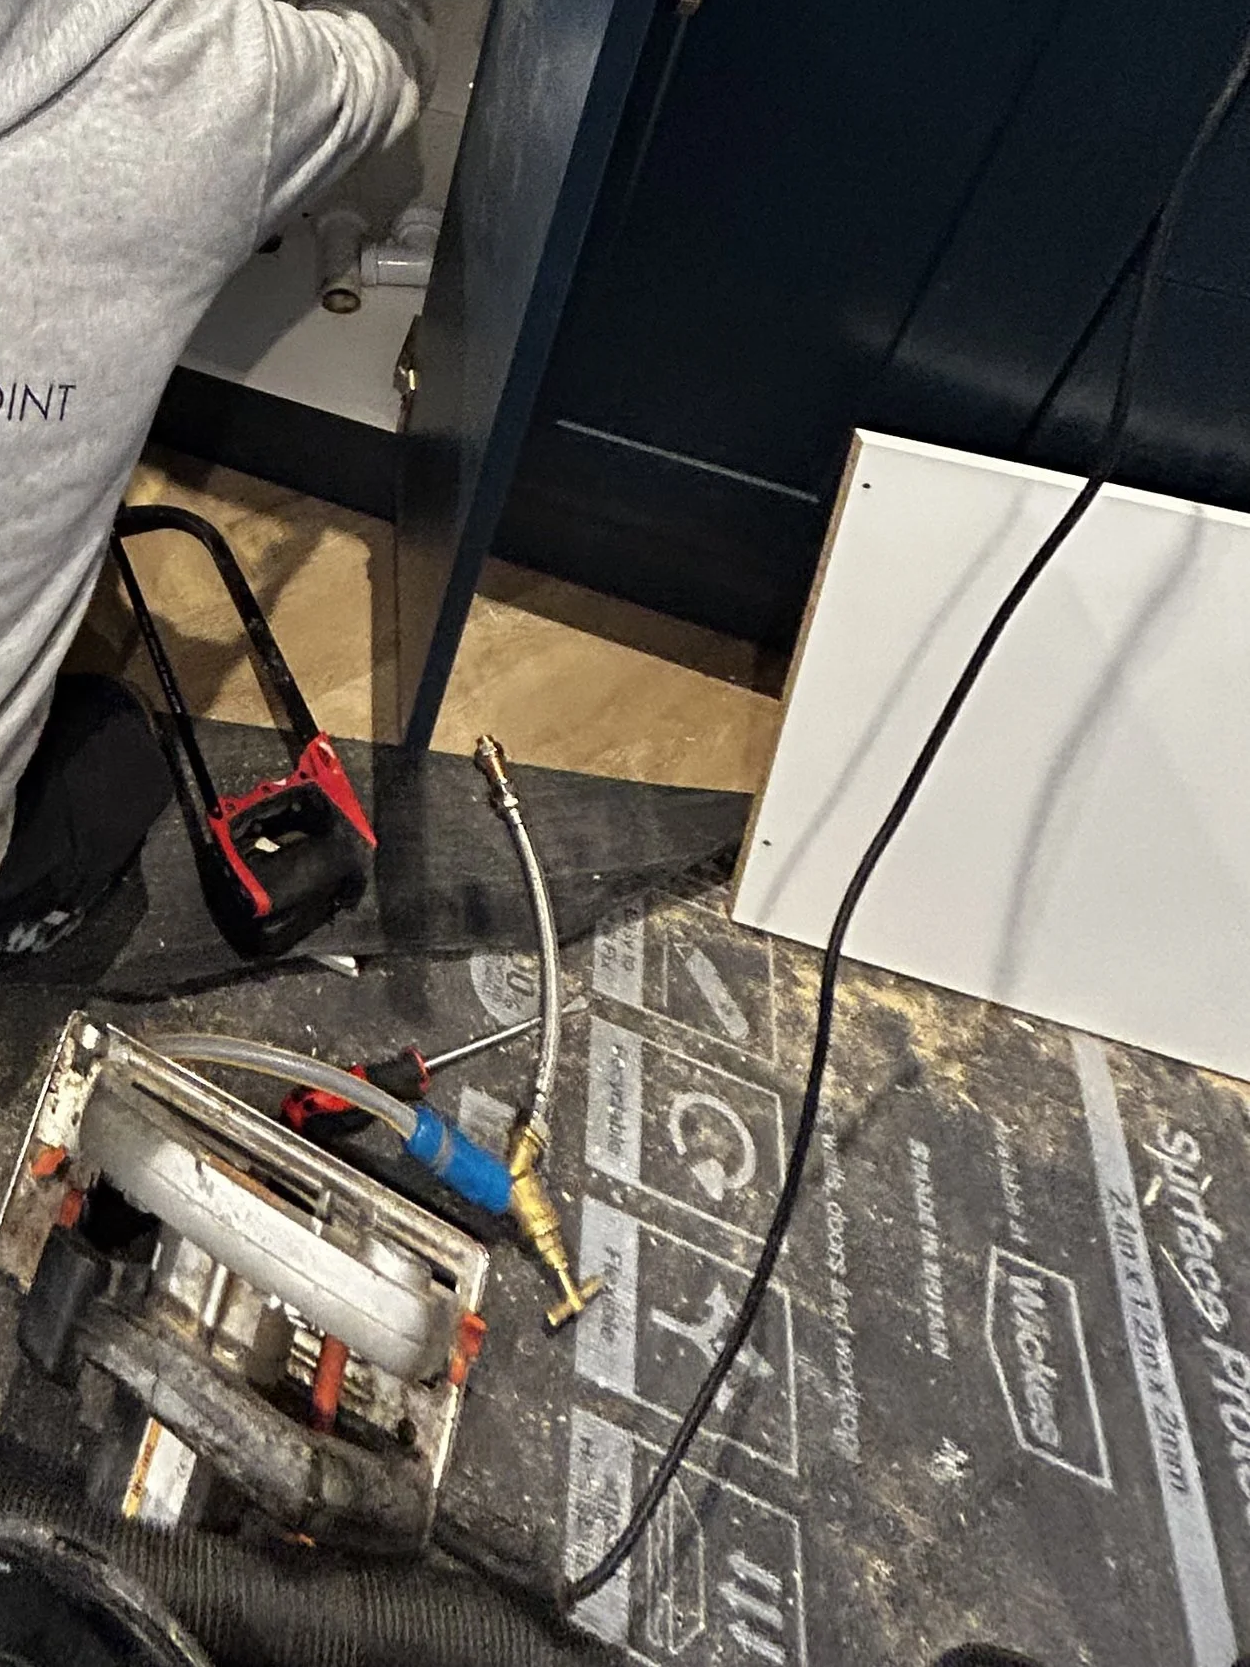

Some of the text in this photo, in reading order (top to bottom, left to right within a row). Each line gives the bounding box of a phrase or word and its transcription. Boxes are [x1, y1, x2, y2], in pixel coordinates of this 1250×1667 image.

[827, 1200, 848, 1275] doors
[1158, 1122, 1231, 1328] Surface
[1008, 1273, 1061, 1449] Wickes
[1152, 1404, 1188, 1493] 2mm
